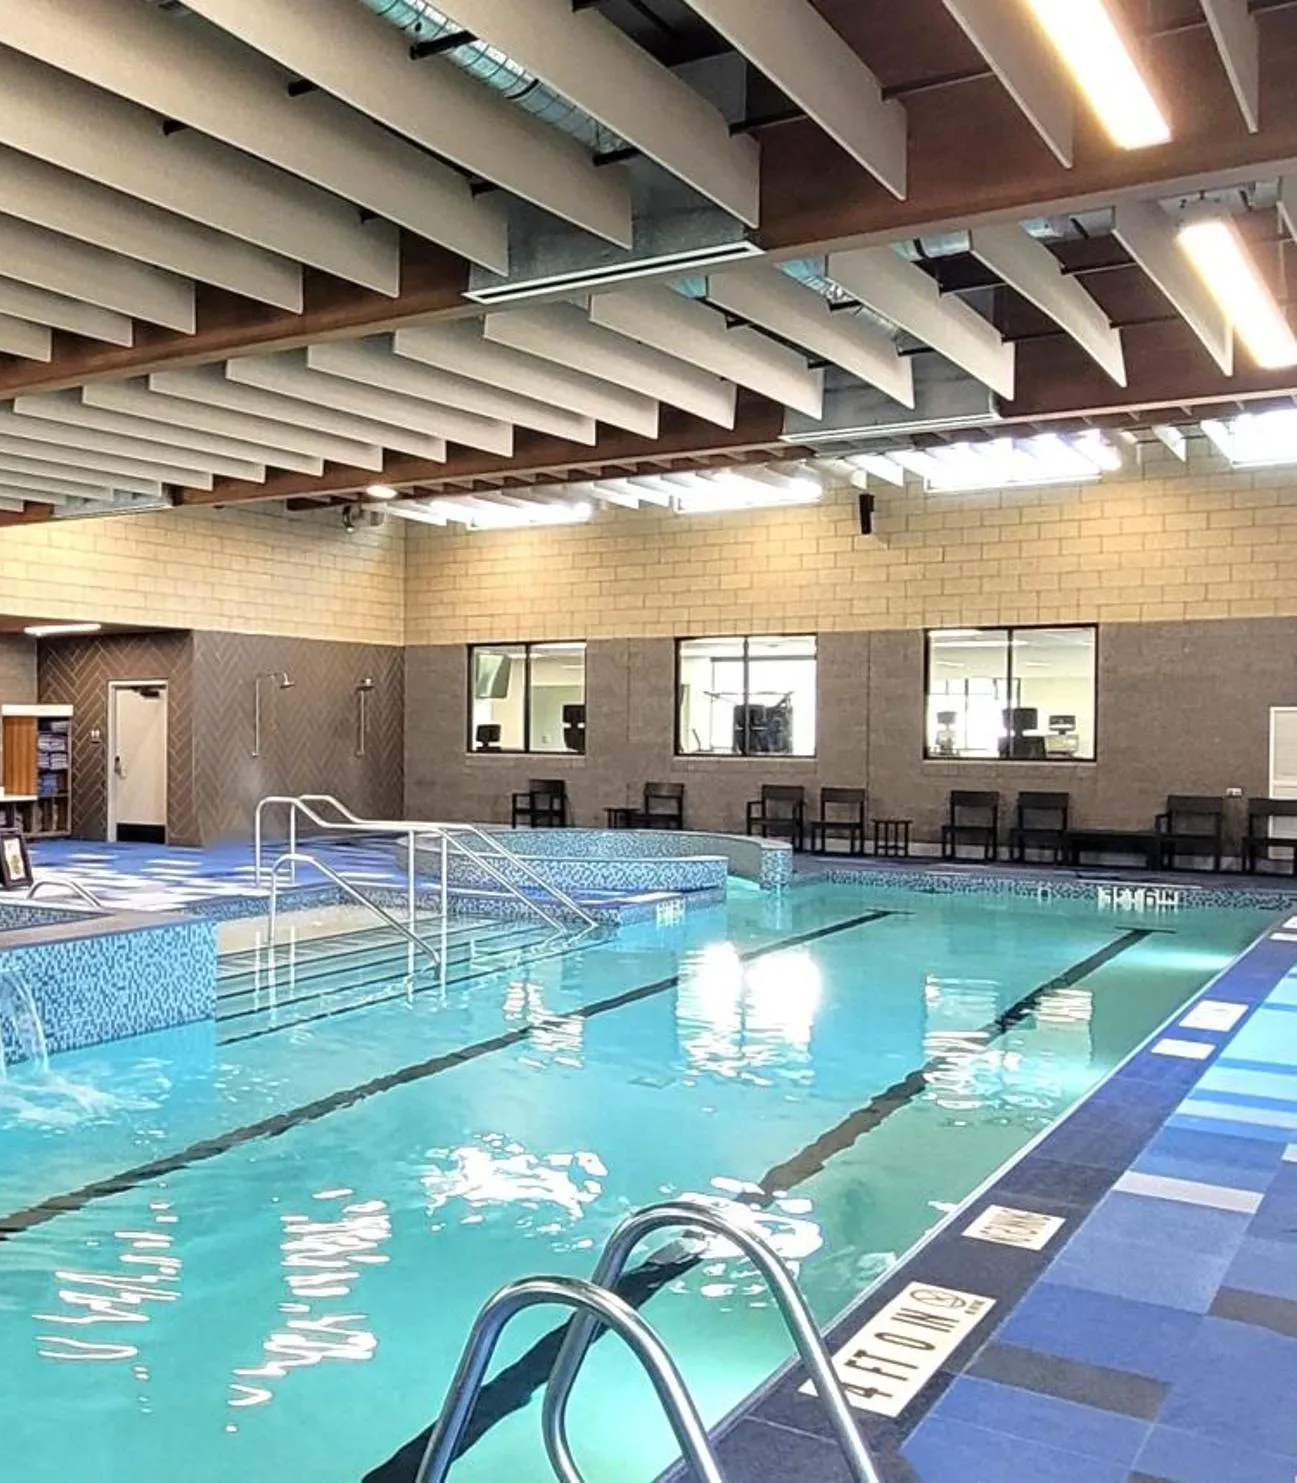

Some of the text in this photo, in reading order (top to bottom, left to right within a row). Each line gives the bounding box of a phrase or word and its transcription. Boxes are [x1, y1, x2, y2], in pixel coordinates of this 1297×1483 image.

[890, 1307, 960, 1333] IN
[844, 1349, 919, 1382] FT
[842, 1382, 895, 1399] 4
